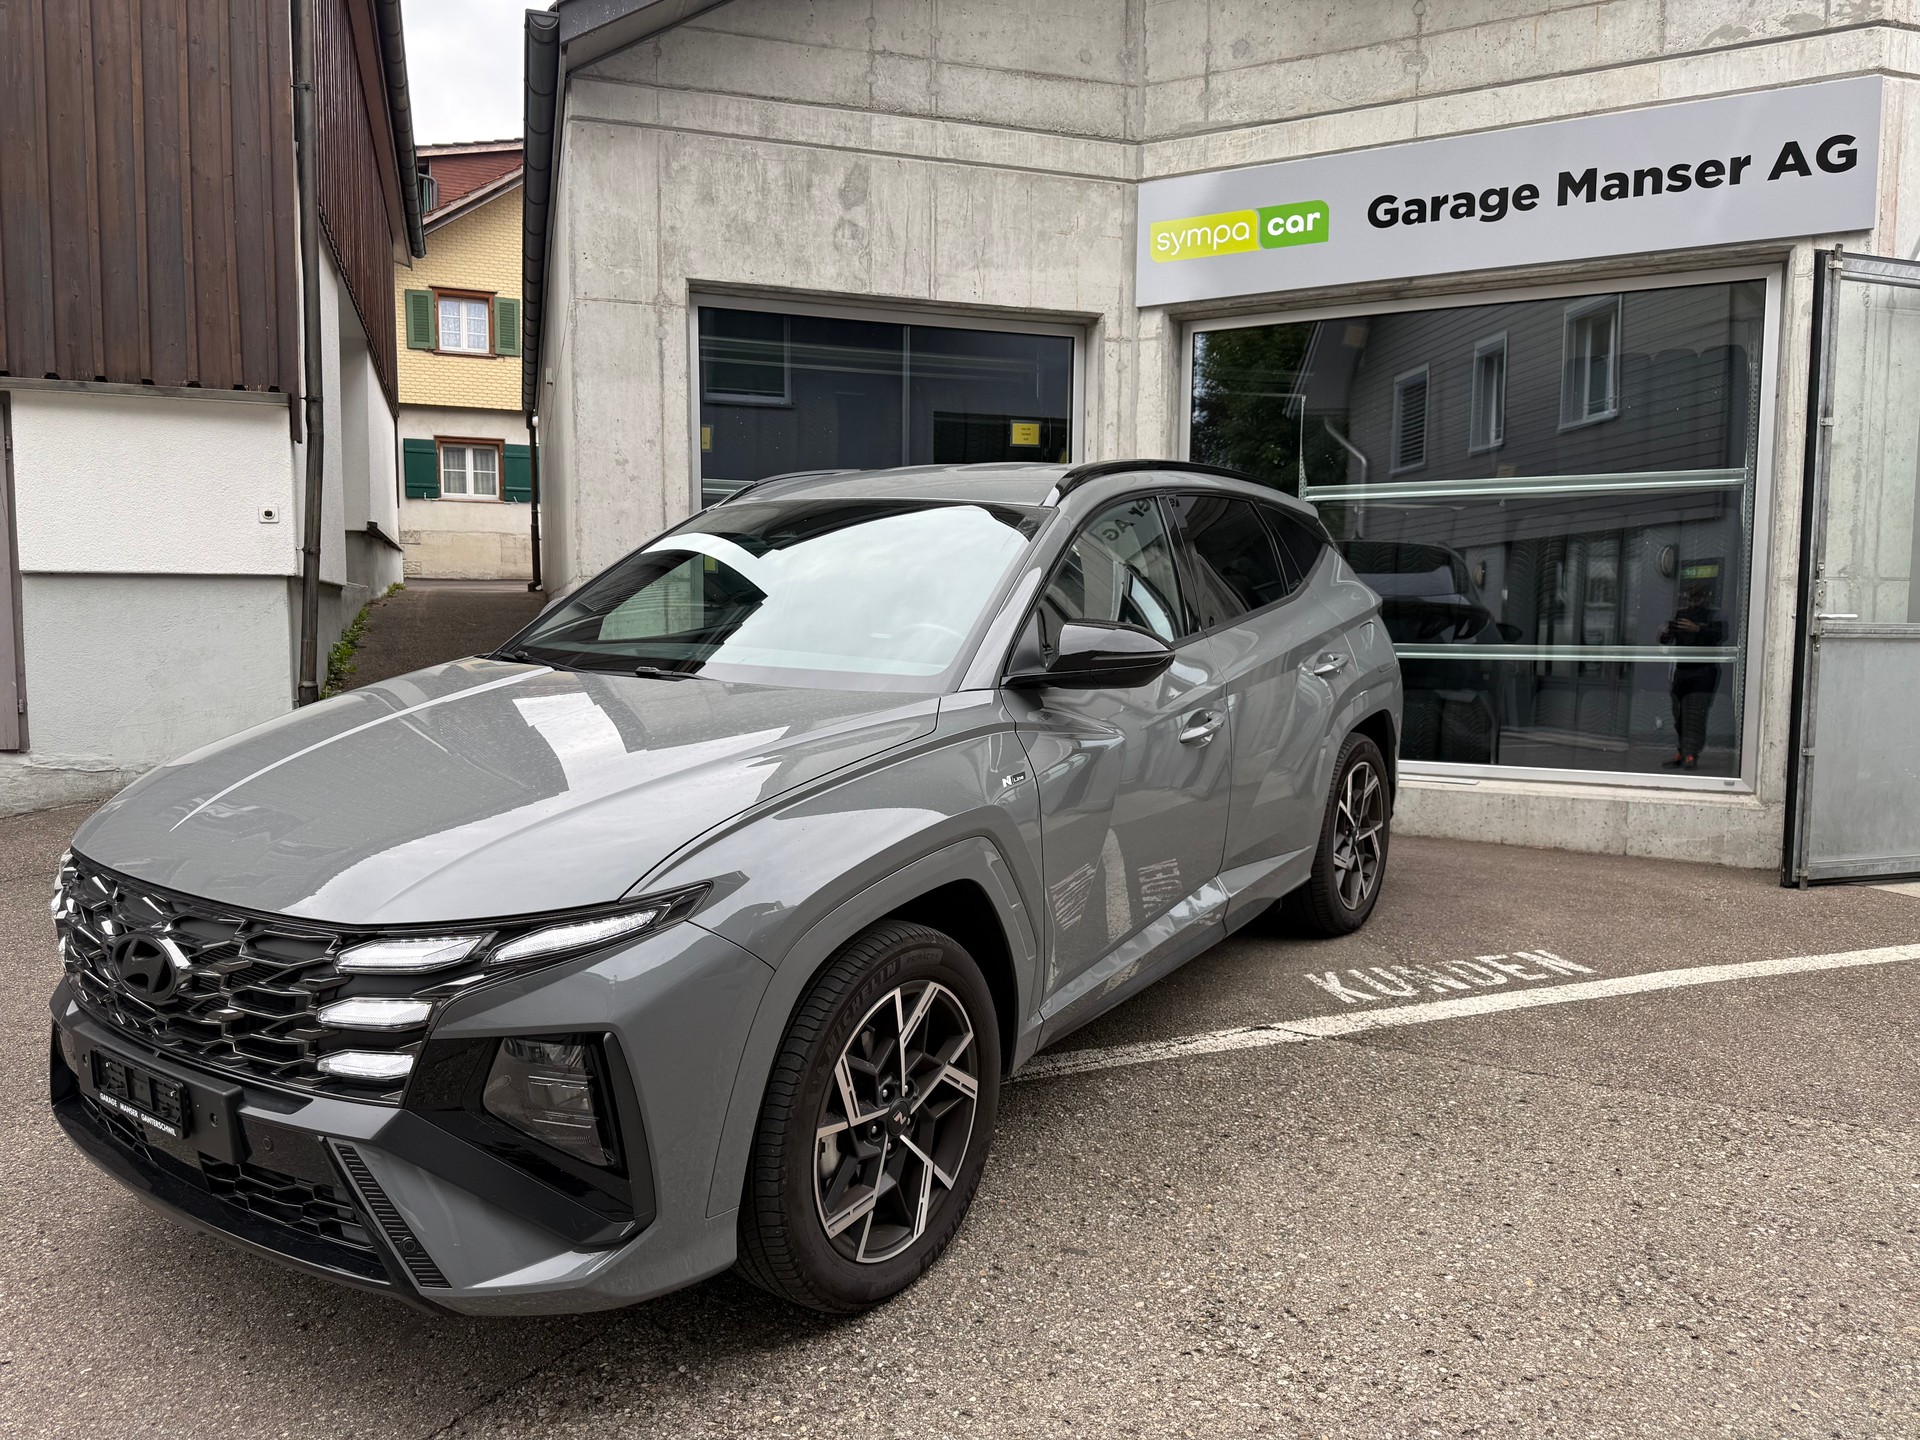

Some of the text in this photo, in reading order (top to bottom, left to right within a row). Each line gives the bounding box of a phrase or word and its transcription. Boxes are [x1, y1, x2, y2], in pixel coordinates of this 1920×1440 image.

[1367, 134, 1858, 229] Garage Manser AG
[1157, 212, 1321, 256] sympa car
[1304, 950, 1597, 1003] KUNDEN
[825, 962, 897, 1059] MICHELIN
[100, 1092, 118, 1108] GARAGE
[120, 1103, 139, 1118] MANSER
